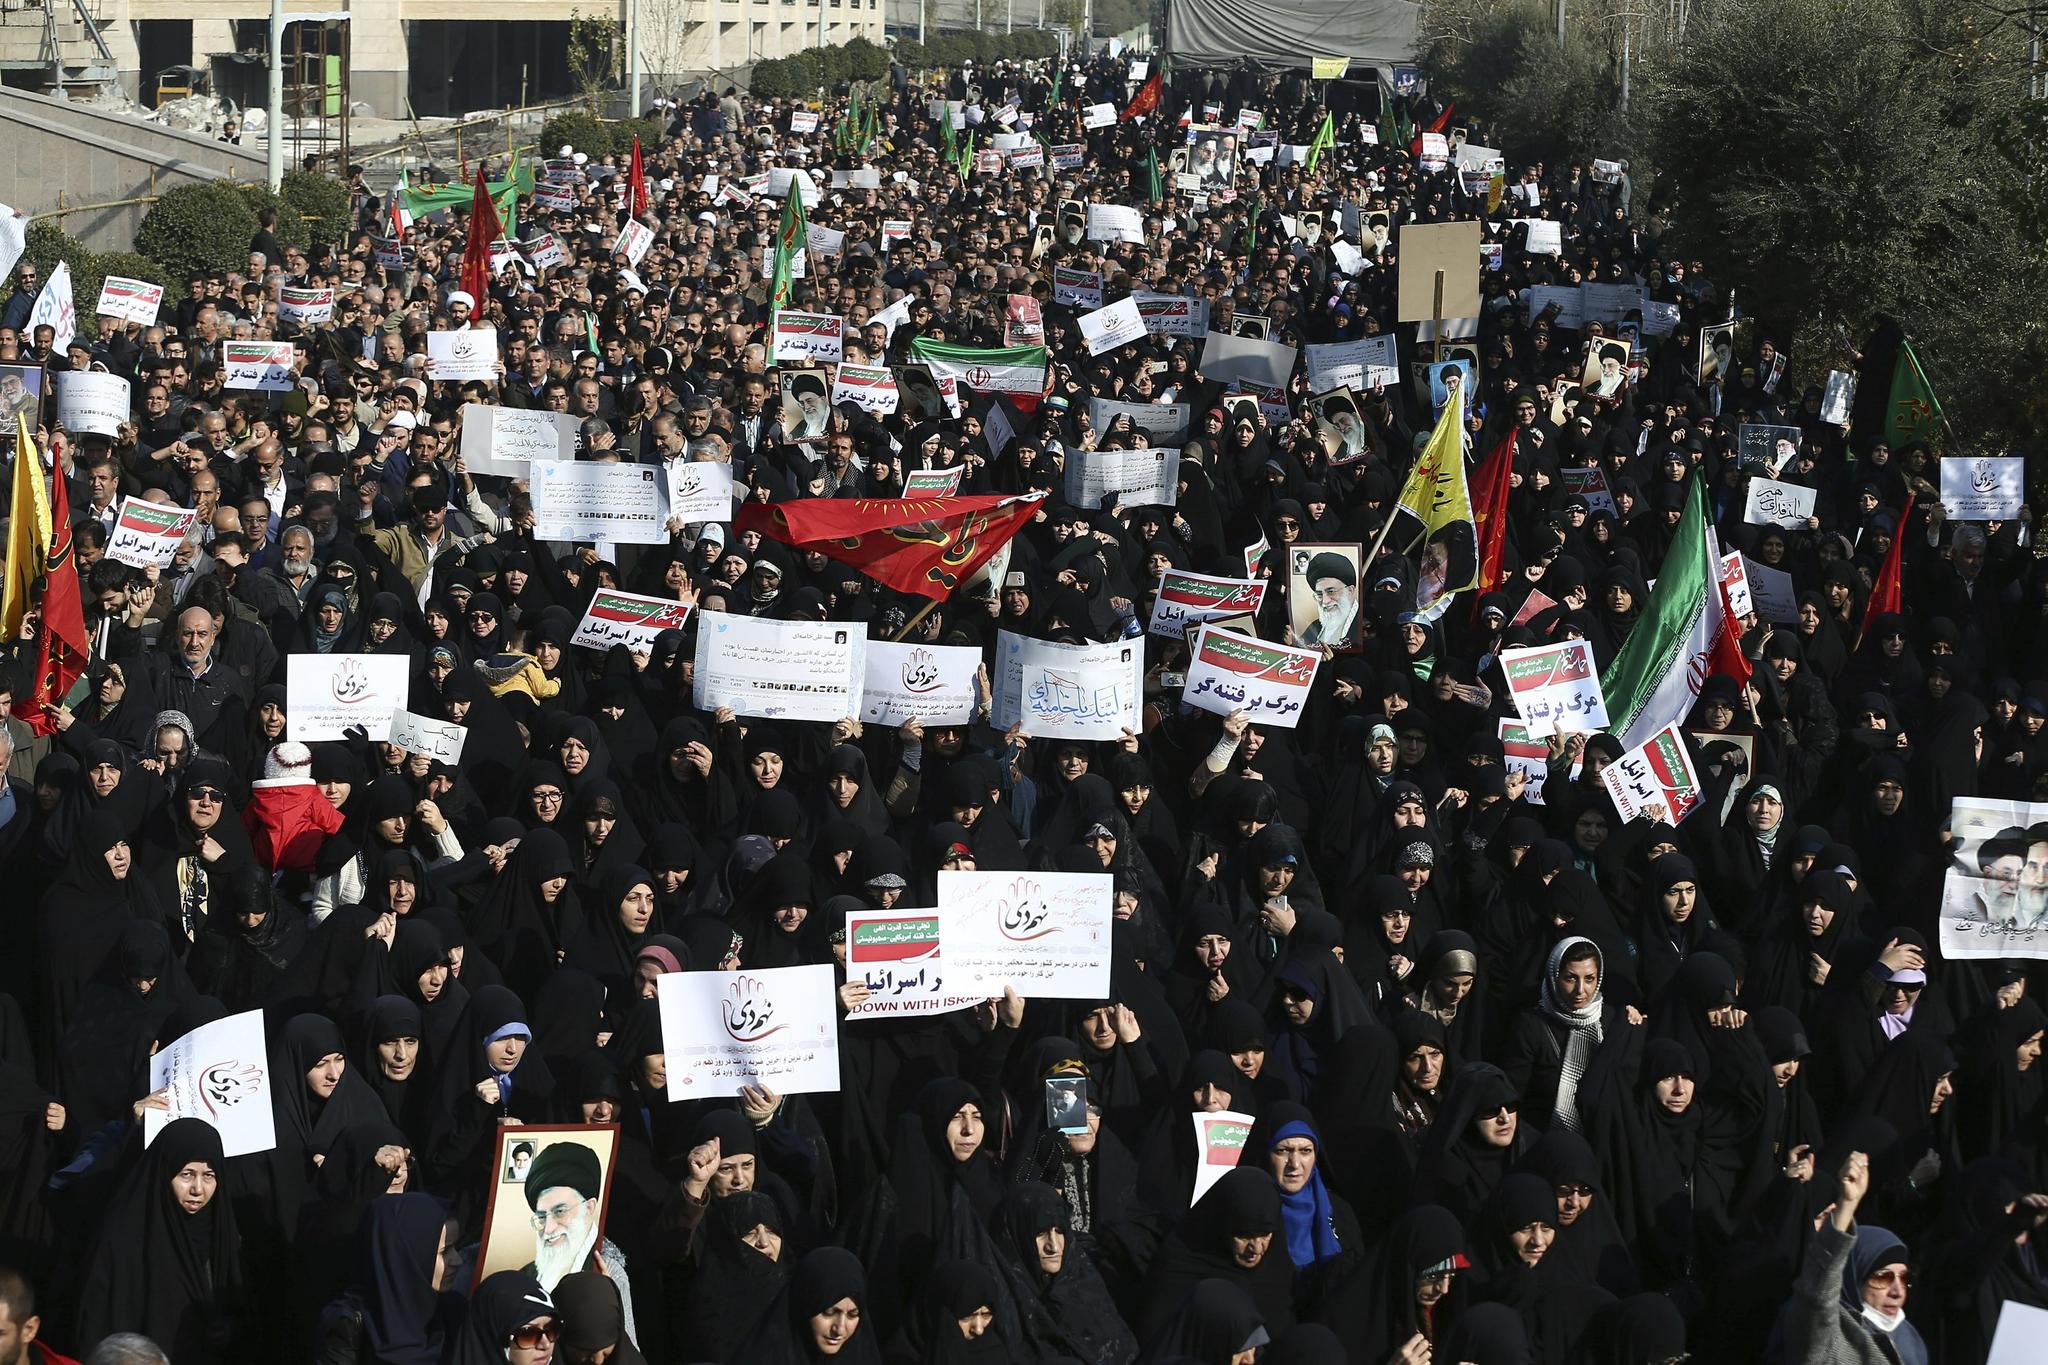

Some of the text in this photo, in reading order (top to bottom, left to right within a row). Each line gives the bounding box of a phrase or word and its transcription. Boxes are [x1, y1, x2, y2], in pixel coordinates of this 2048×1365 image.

[102, 298, 129, 307] اسرائیل
[138, 306, 154, 315] مرگ
[809, 344, 817, 353] بر
[820, 343, 839, 355] مرگ
[259, 373, 268, 383] بر
[867, 397, 876, 406] بر
[877, 395, 896, 407] مرگ
[678, 477, 692, 492] دی
[1975, 472, 1987, 487] دی
[115, 534, 156, 552] اسرائیل
[109, 551, 135, 562] DOWN
[155, 546, 164, 557] بر
[583, 622, 643, 646] بر اسرائیل
[1154, 624, 1184, 636] DOWN
[576, 636, 607, 647] DOWN
[907, 665, 925, 684] دی
[337, 674, 356, 695] دی
[1244, 696, 1263, 711] بر
[1265, 695, 1299, 714] مرگ
[1567, 689, 1598, 714] مرگ
[1552, 701, 1564, 721] بر
[407, 714, 461, 741] لبیک یا
[1620, 759, 1654, 799] اسرائیل
[1606, 769, 1635, 819] DOWN WITH
[1005, 900, 1030, 930] دی
[874, 924, 886, 932] الهی
[887, 923, 901, 932] قدرت
[852, 1002, 898, 1014] DOWN
[903, 999, 939, 1011] WITH
[730, 999, 755, 1030] دی
[803, 1053, 814, 1062] قوی
[209, 1069, 240, 1092] دی
